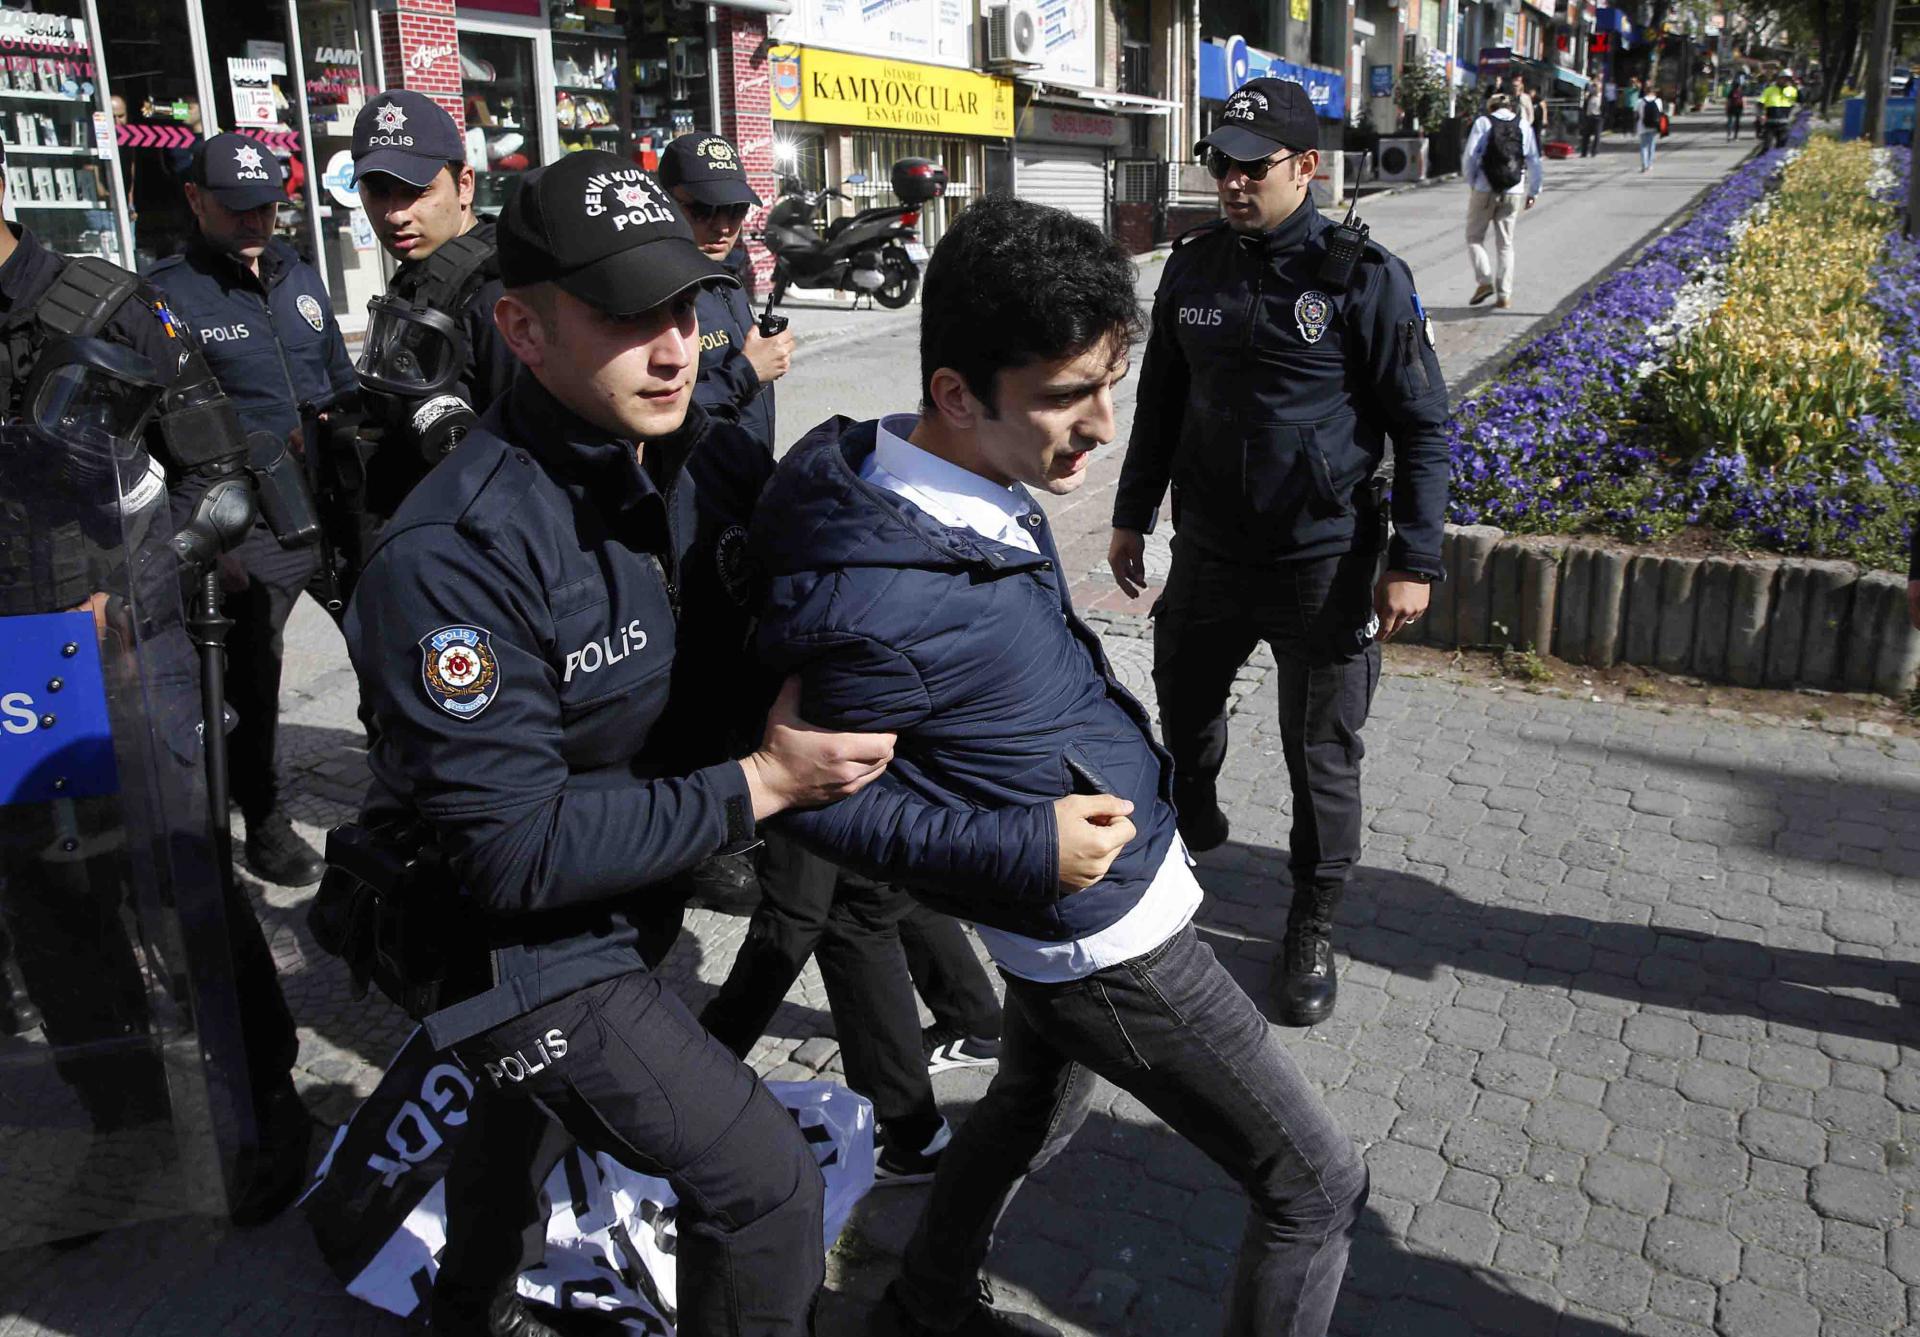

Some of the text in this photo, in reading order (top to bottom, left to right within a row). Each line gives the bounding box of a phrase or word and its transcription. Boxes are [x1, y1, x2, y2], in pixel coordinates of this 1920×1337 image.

[315, 46, 363, 65] LAMY
[411, 43, 453, 69] Ajans
[883, 66, 922, 82] İSTANBUL
[813, 71, 979, 116] KAMYONCULAR
[866, 106, 903, 122] ESNAF
[1224, 109, 1255, 120] POLİS
[369, 135, 414, 147] POLİS
[236, 169, 269, 180] POLİS
[585, 173, 613, 216] ÇEVİK
[612, 203, 675, 232] POLİS
[1178, 306, 1223, 326] POLİS
[200, 323, 250, 344] POLİS
[439, 629, 470, 643] POLİS
[563, 618, 648, 683] POLİS
[483, 1027, 569, 1089] POLİS
